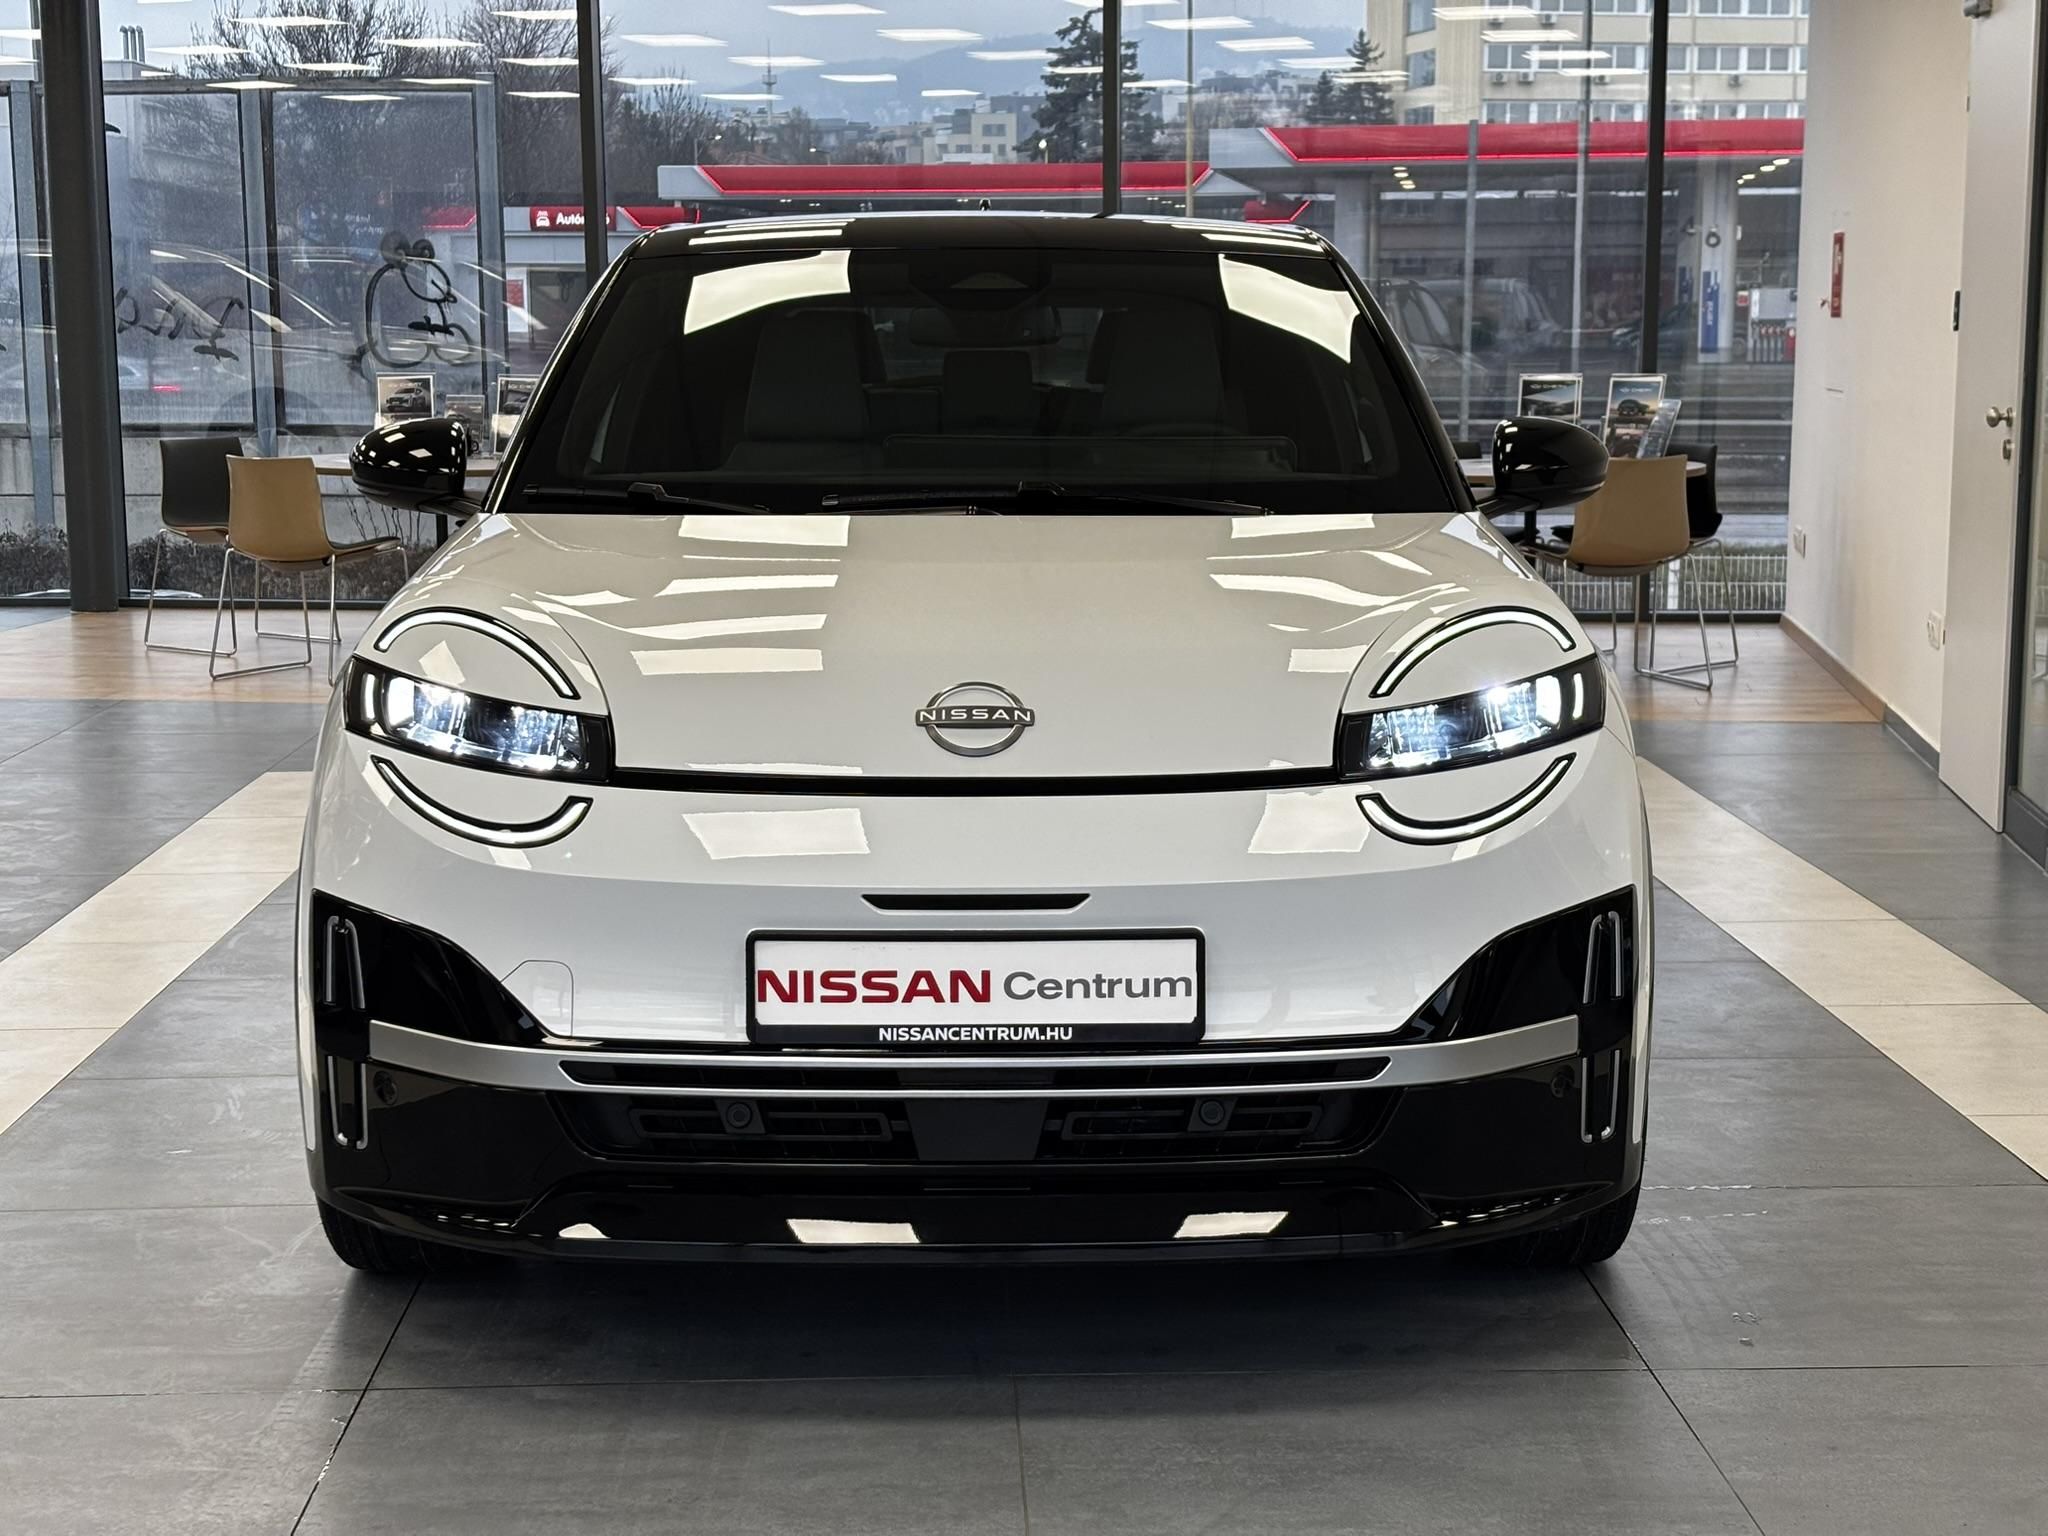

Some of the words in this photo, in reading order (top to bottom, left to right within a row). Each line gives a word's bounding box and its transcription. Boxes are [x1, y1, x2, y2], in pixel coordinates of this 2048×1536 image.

[919, 708, 1031, 722] NISSAN
[757, 969, 991, 1003] NISSAN
[1003, 970, 1193, 1001] Centrum
[878, 1025, 1074, 1042] NISSANCENTRUM.HU
